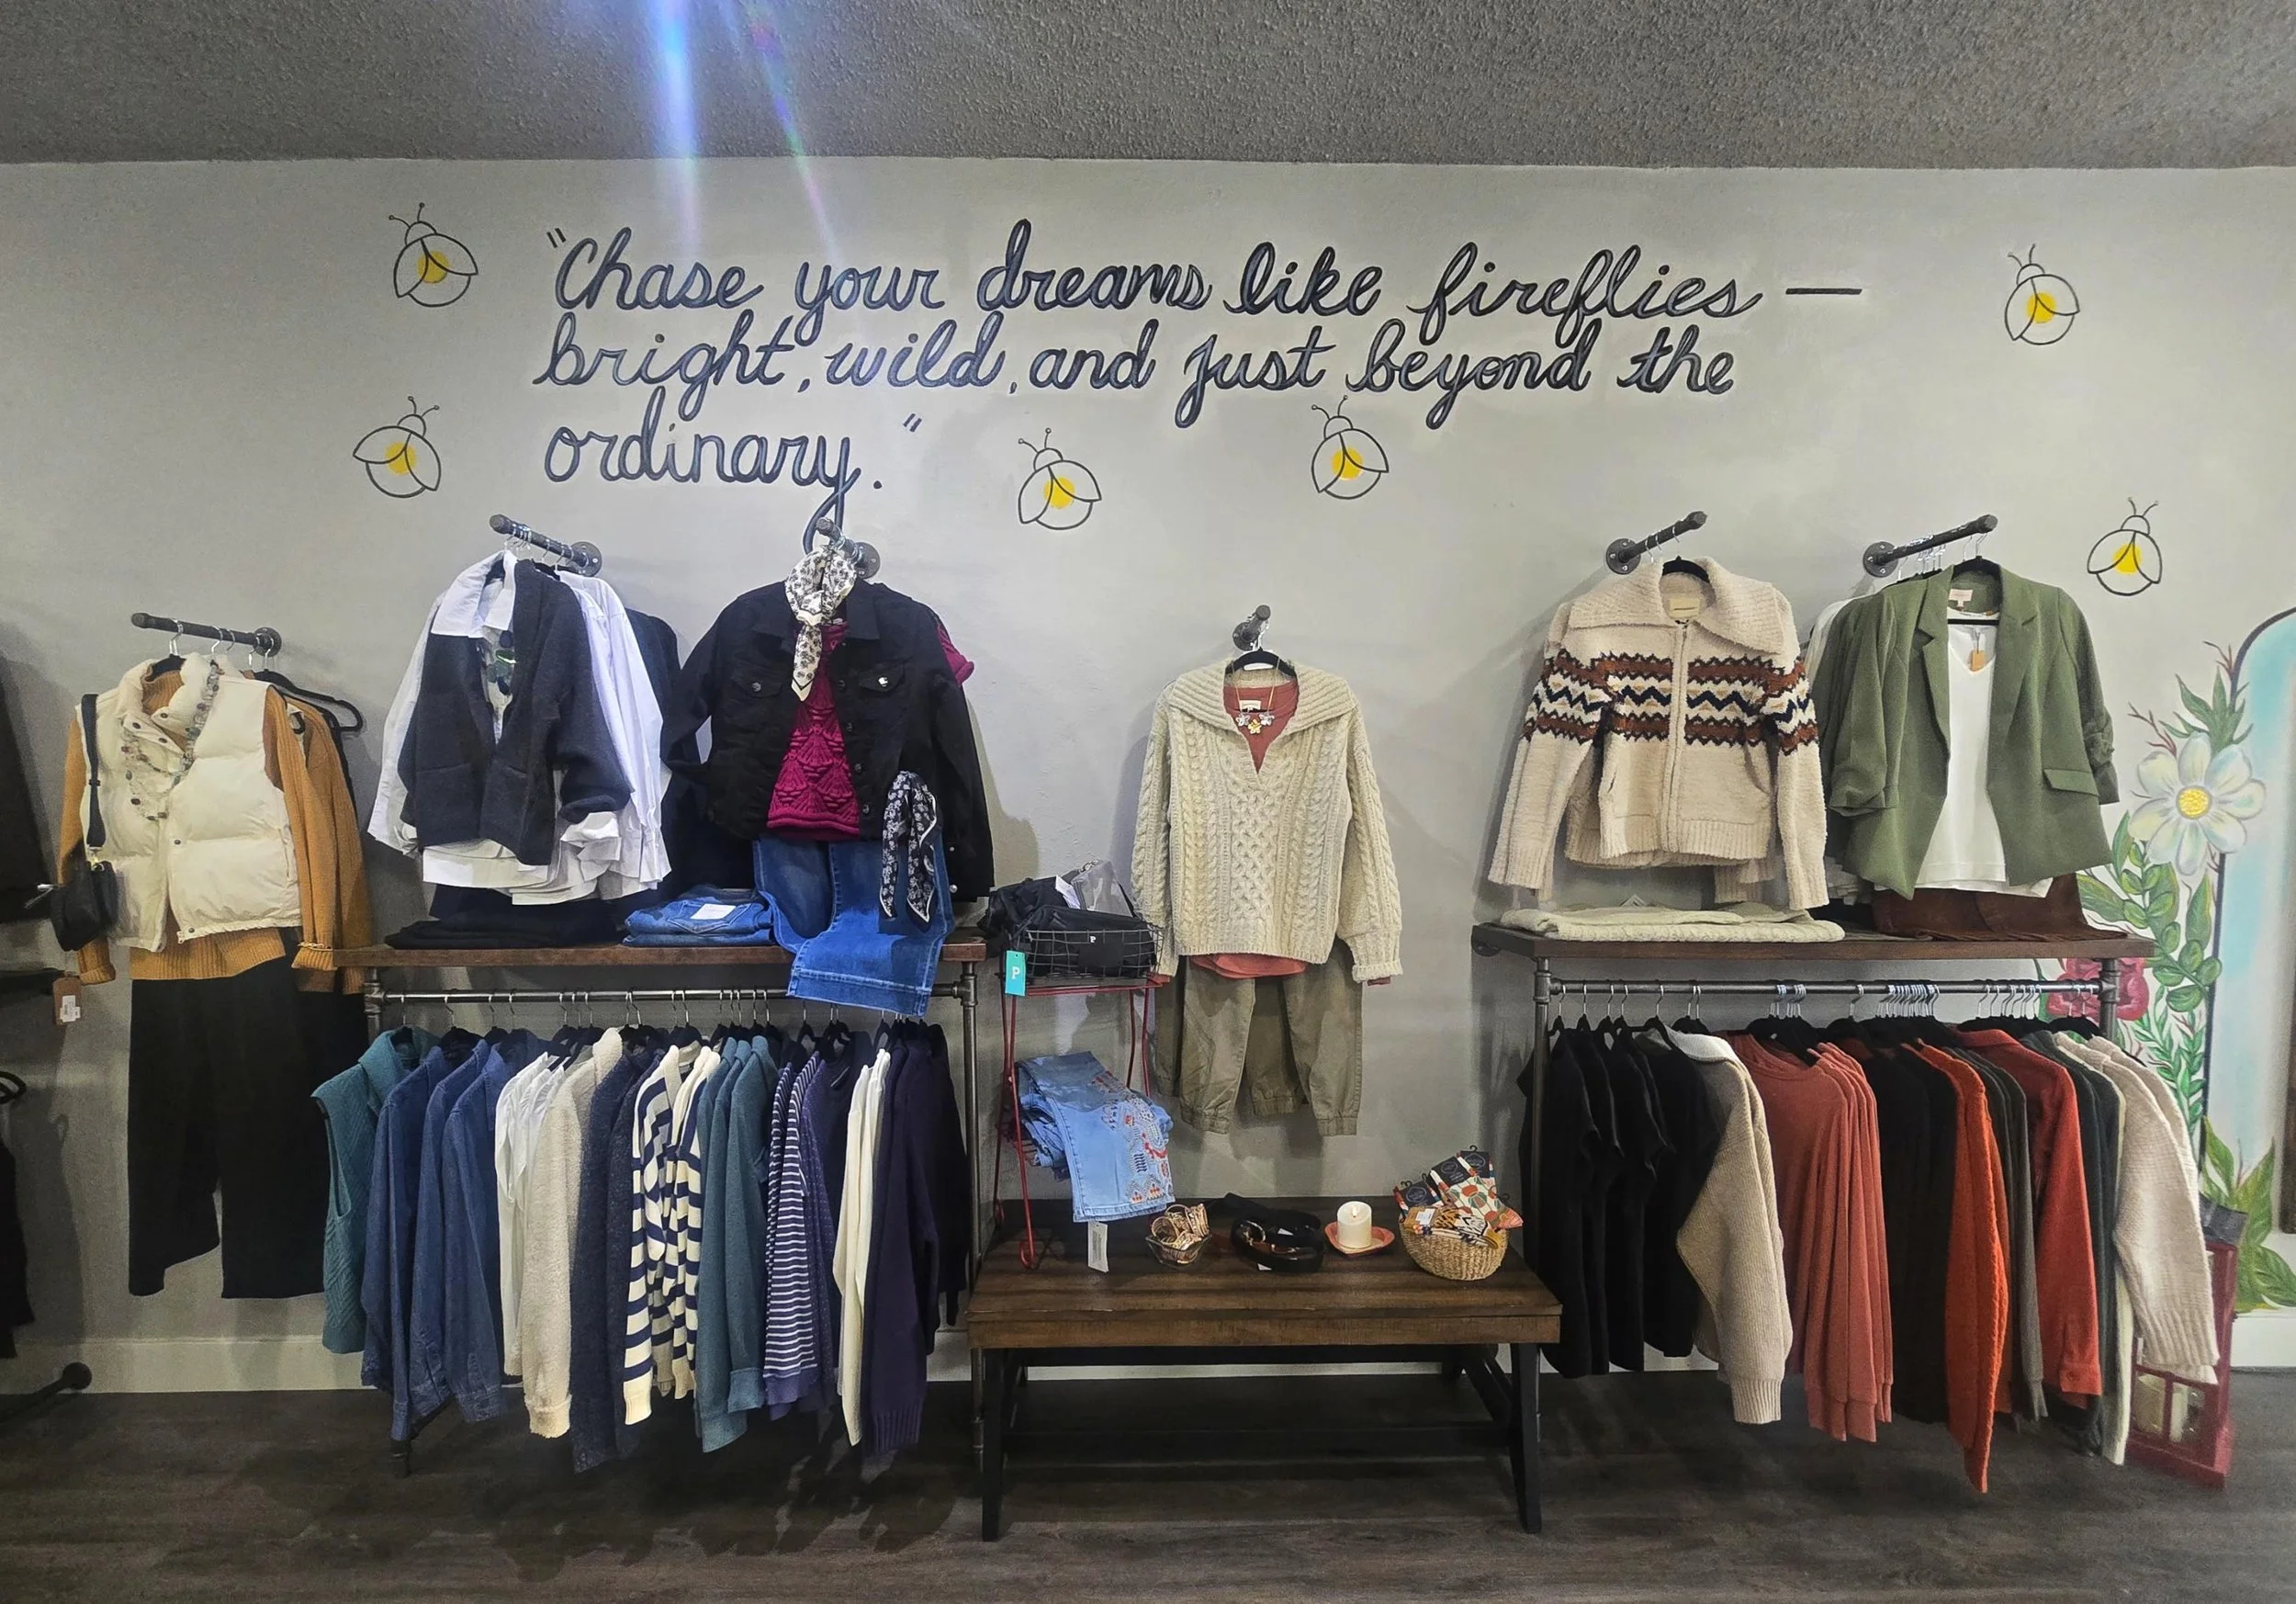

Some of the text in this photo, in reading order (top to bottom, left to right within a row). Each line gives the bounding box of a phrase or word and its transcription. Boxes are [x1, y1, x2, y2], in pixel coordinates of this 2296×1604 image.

[793, 261, 946, 347] your
[976, 218, 1213, 312] dreams
[1222, 241, 1383, 317] like
[1405, 241, 1764, 350] fireflies
[1029, 318, 1160, 390] and
[1174, 325, 1337, 429] just
[1345, 318, 1603, 431] beyond
[1616, 323, 1735, 395] the
[1011, 966, 1020, 980] P
